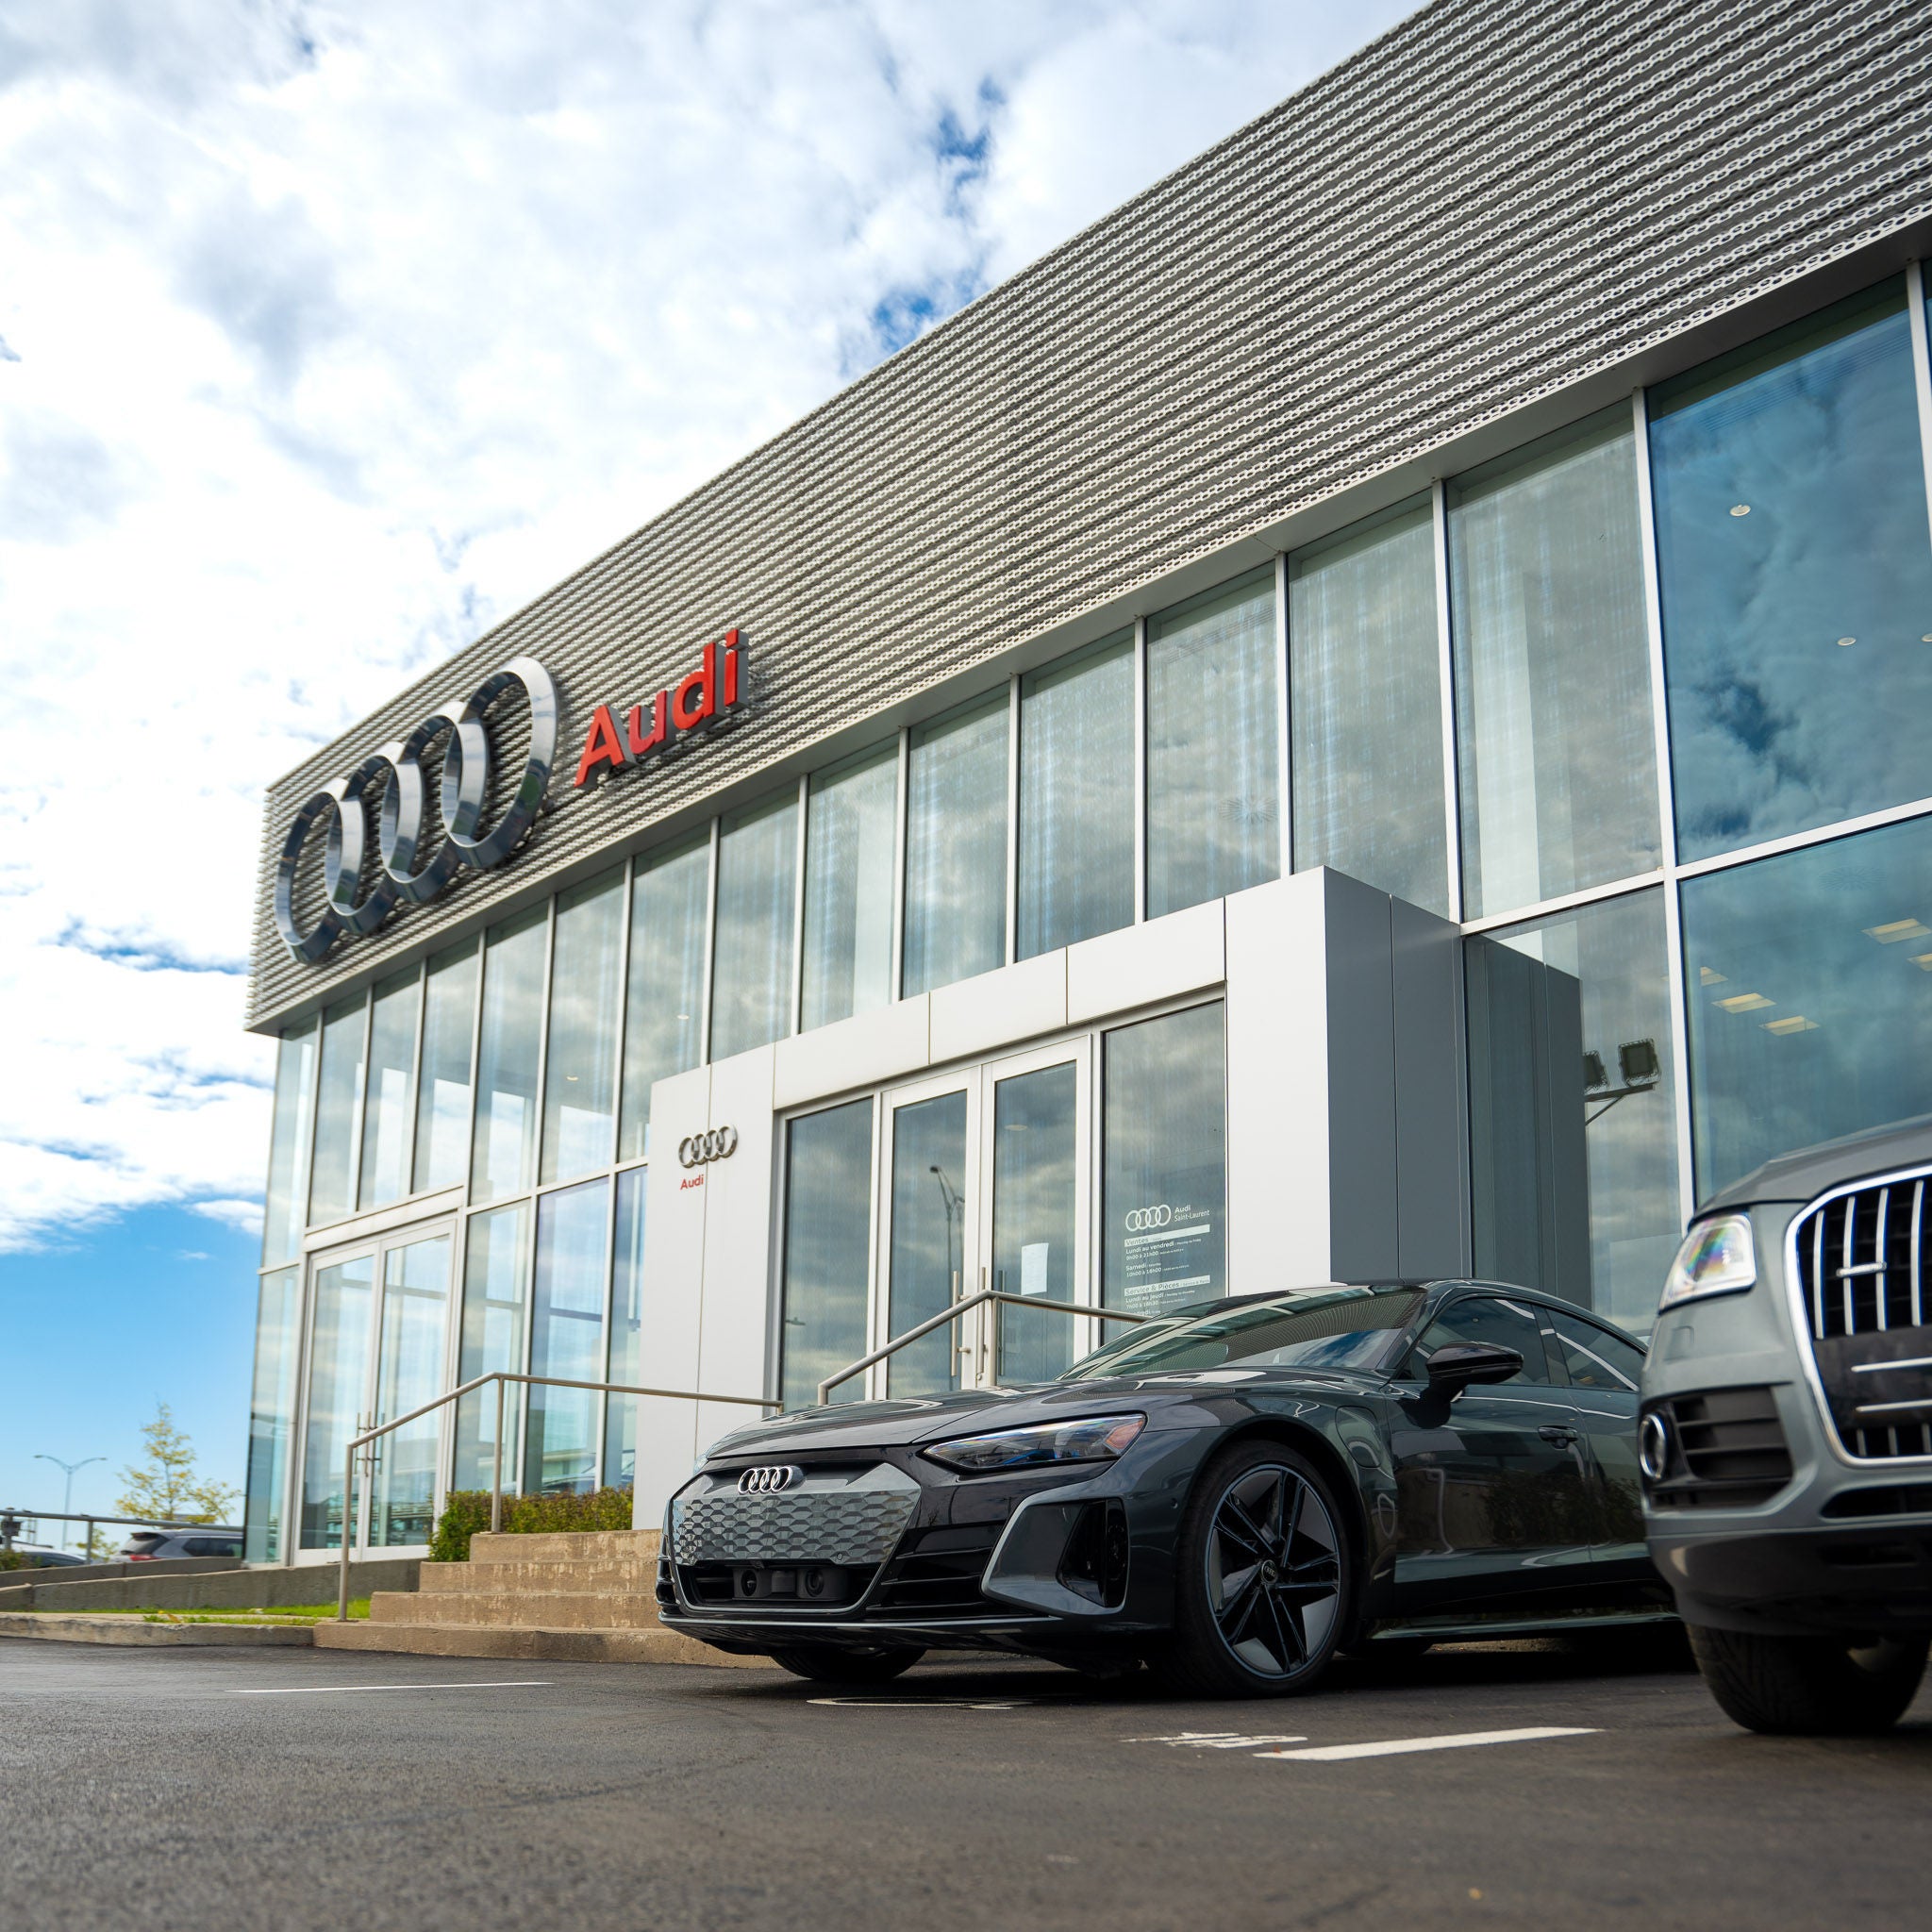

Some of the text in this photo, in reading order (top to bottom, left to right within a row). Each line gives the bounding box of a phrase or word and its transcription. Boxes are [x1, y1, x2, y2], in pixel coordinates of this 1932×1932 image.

[574, 628, 743, 789] Audi
[680, 1174, 704, 1191] Audi
[1174, 1205, 1191, 1213] Audi
[1174, 1209, 1210, 1222] Saint-Laurent
[1125, 1237, 1149, 1246] Ventes
[1125, 1246, 1141, 1255] Lundi
[1150, 1241, 1174, 1251] vendredi
[1125, 1262, 1147, 1272] Samedi
[1125, 1286, 1150, 1295] Service
[1158, 1281, 1180, 1291] Pièces
